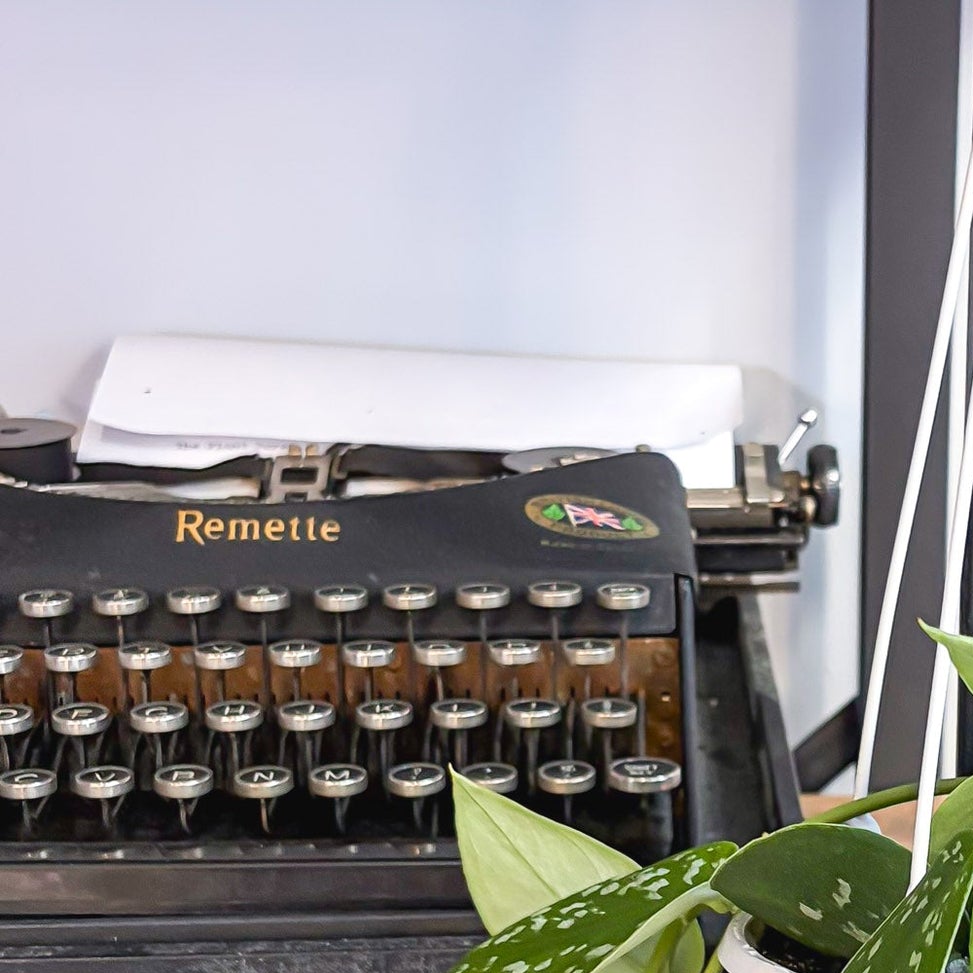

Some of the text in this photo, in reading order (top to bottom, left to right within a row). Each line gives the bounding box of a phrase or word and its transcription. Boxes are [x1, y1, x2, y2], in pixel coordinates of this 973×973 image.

[175, 509, 342, 546] Remette
[252, 770, 275, 783] N
[323, 769, 351, 781] M
